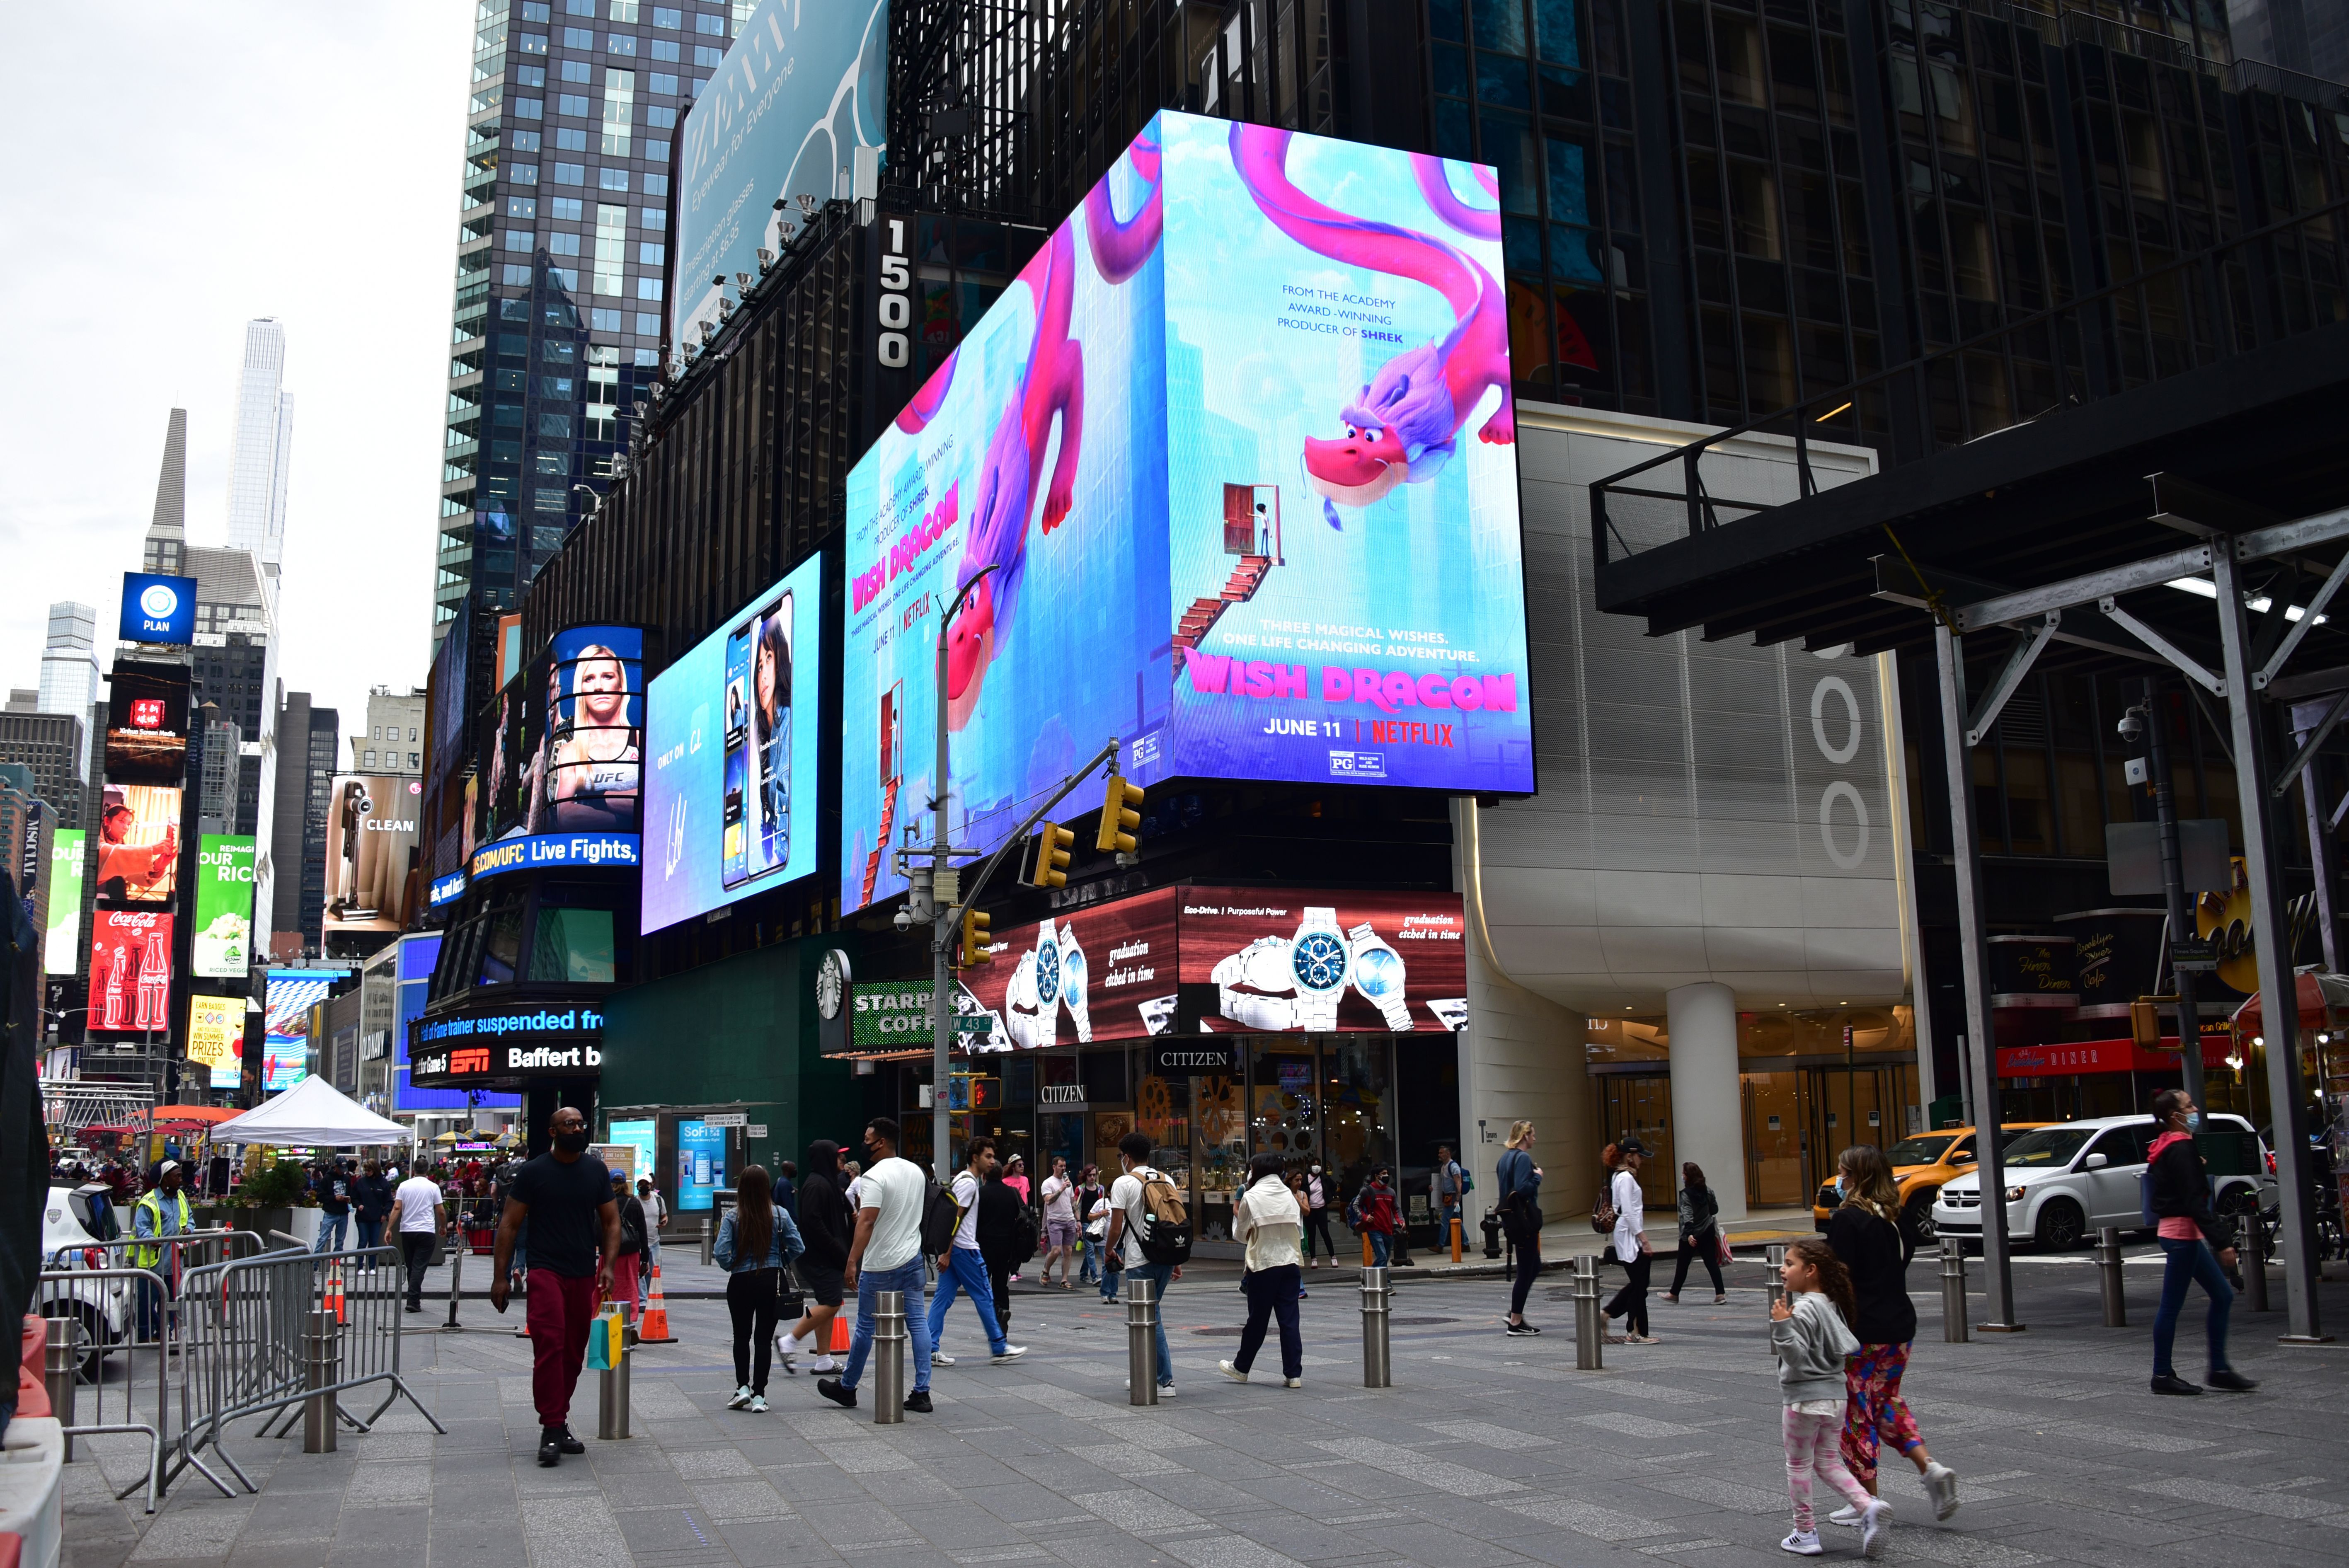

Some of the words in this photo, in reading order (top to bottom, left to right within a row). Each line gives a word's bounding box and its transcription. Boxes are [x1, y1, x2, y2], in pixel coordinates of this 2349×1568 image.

[693, 149, 729, 213] Eyewear
[731, 126, 745, 157] for
[747, 56, 794, 134] Everyone
[685, 217, 725, 279] Prescription
[727, 178, 754, 225] glasses
[684, 267, 710, 305] starting
[711, 250, 719, 266] at
[720, 220, 739, 259] $6.95
[879, 220, 910, 367] 1500
[1283, 285, 1313, 297] FROM
[1317, 290, 1339, 301] THE
[1342, 294, 1396, 309] ACADEMY
[1288, 303, 1331, 316] AWARD
[1278, 318, 1339, 334] PRODUCER
[1342, 327, 1357, 336] OF
[1361, 329, 1403, 344] SHREK
[856, 523, 868, 546] FROM
[869, 512, 878, 531] THE
[879, 487, 902, 521] ACADEMY
[903, 467, 923, 496] AWARD
[874, 518, 900, 550] PRODUCER
[901, 507, 908, 522] OF
[909, 484, 929, 514] SHREK
[852, 555, 886, 616] WISH
[890, 476, 959, 582] DRAGON
[851, 623, 862, 639] THREE
[862, 611, 877, 629] MAGICAL
[878, 599, 892, 615] WISHES.
[893, 589, 901, 603] ONE
[910, 562, 932, 587] CHANGING
[932, 537, 959, 567] ADVENTURE.
[144, 620, 170, 632] PLAN
[873, 629, 888, 654] JUNE
[889, 626, 895, 644] 11
[903, 590, 930, 633] NETFLIX
[1260, 619, 1310, 634] THREE
[1315, 622, 1384, 639] MAGICAL
[1388, 629, 1449, 644] WISHES.
[1223, 632, 1257, 647] ONE
[1261, 635, 1292, 649] LIFE
[1296, 637, 1381, 655] CHANGING
[1385, 643, 1480, 662] ADVENTURE.
[1183, 645, 1307, 699] WISH
[1322, 665, 1517, 714] DRAGON
[1264, 718, 1317, 737] JUNE
[1323, 721, 1340, 738] 11
[1372, 720, 1453, 748] NETFLIX
[658, 749, 673, 769] ONLY
[674, 741, 684, 760] ON
[1133, 747, 1144, 761] PG
[1332, 758, 1353, 769] PG
[593, 772, 624, 784] UFC
[366, 819, 414, 832] CLEAN
[199, 852, 232, 865] OUR
[532, 841, 565, 861] Live
[571, 839, 637, 864] Fights,
[218, 866, 252, 882] RIC
[441, 879, 452, 898] and
[109, 911, 159, 928] Coca-Cola
[1228, 907, 1264, 916] Purposeful
[1403, 914, 1454, 927] graduation
[1398, 929, 1426, 939] etched
[1428, 929, 1438, 939] in
[1441, 929, 1460, 940] time
[2075, 932, 2114, 957] Brooklyn
[998, 942, 1008, 951] Power
[1109, 939, 1148, 967] graduation
[2035, 947, 2051, 958] The
[2018, 956, 2051, 973] Finer
[1105, 968, 1126, 988] etched
[1128, 968, 1136, 983] in
[1138, 965, 1154, 982] time
[2038, 974, 2071, 989] Diner
[2083, 968, 2106, 989] Cafe
[855, 990, 958, 1011] STARBC
[429, 1022, 434, 1040] of
[434, 1021, 447, 1039] Fame
[448, 1017, 475, 1036] trainer
[477, 1010, 575, 1036] suspended
[879, 1014, 935, 1033] COFF
[953, 1018, 962, 1030] W
[966, 1018, 979, 1030] 43
[192, 1041, 224, 1056] PRIZES
[362, 1035, 371, 1062] OLD
[371, 1029, 385, 1059] NAVY
[426, 1056, 441, 1073] Game
[441, 1053, 446, 1072] 5
[450, 1048, 489, 1073] ESPN
[509, 1047, 580, 1068] Baffert
[1160, 1052, 1227, 1066] CITIZEN
[2051, 1050, 2097, 1065] DINER
[1041, 1084, 1085, 1103] CITIZEN
[684, 1126, 707, 1137] SoFi
